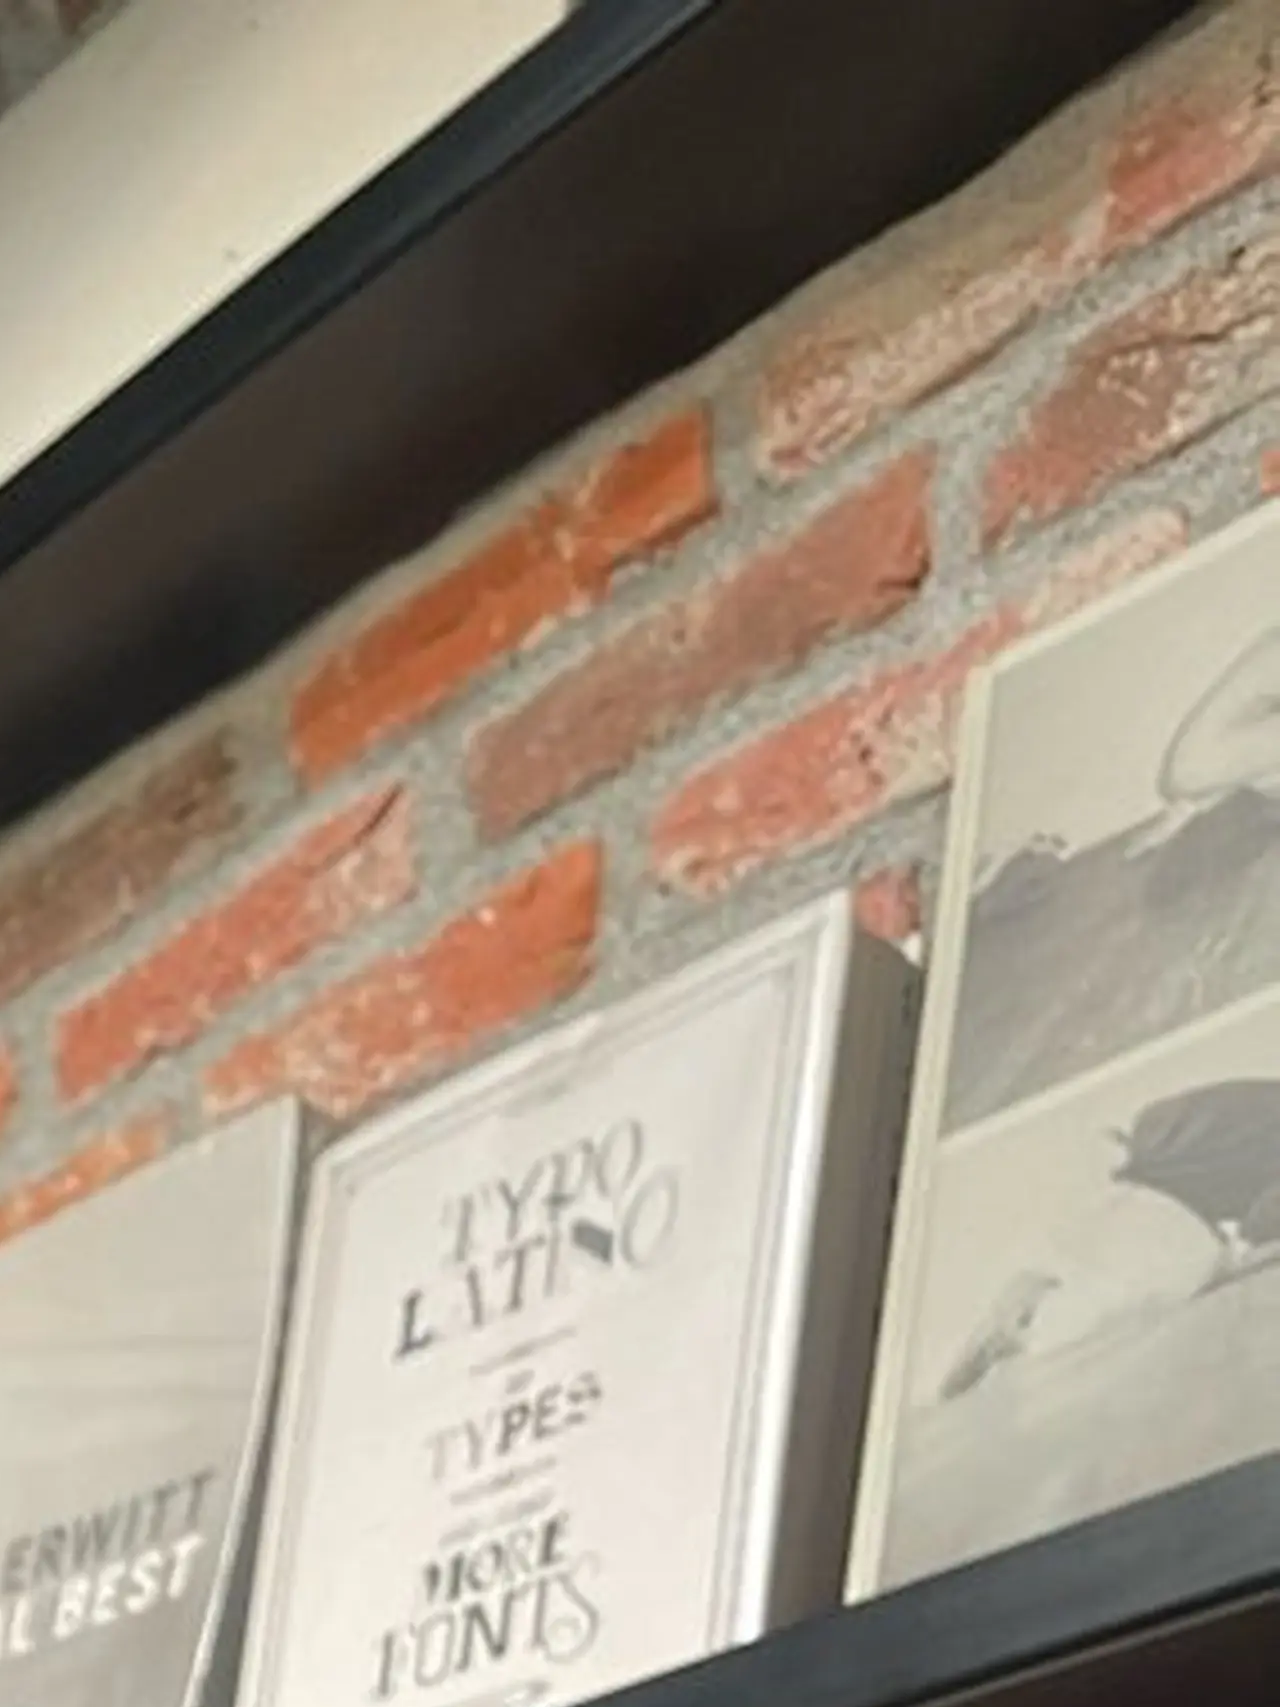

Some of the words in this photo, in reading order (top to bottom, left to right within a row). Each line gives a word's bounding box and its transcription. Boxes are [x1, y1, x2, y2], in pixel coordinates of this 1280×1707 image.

[444, 1118, 648, 1262] TYPO
[390, 1166, 680, 1362] LATINO
[424, 1370, 604, 1482] TYPES
[0, 1466, 218, 1597] ERWITT
[50, 1531, 207, 1642] BEST
[370, 1550, 602, 1702] FONTS
